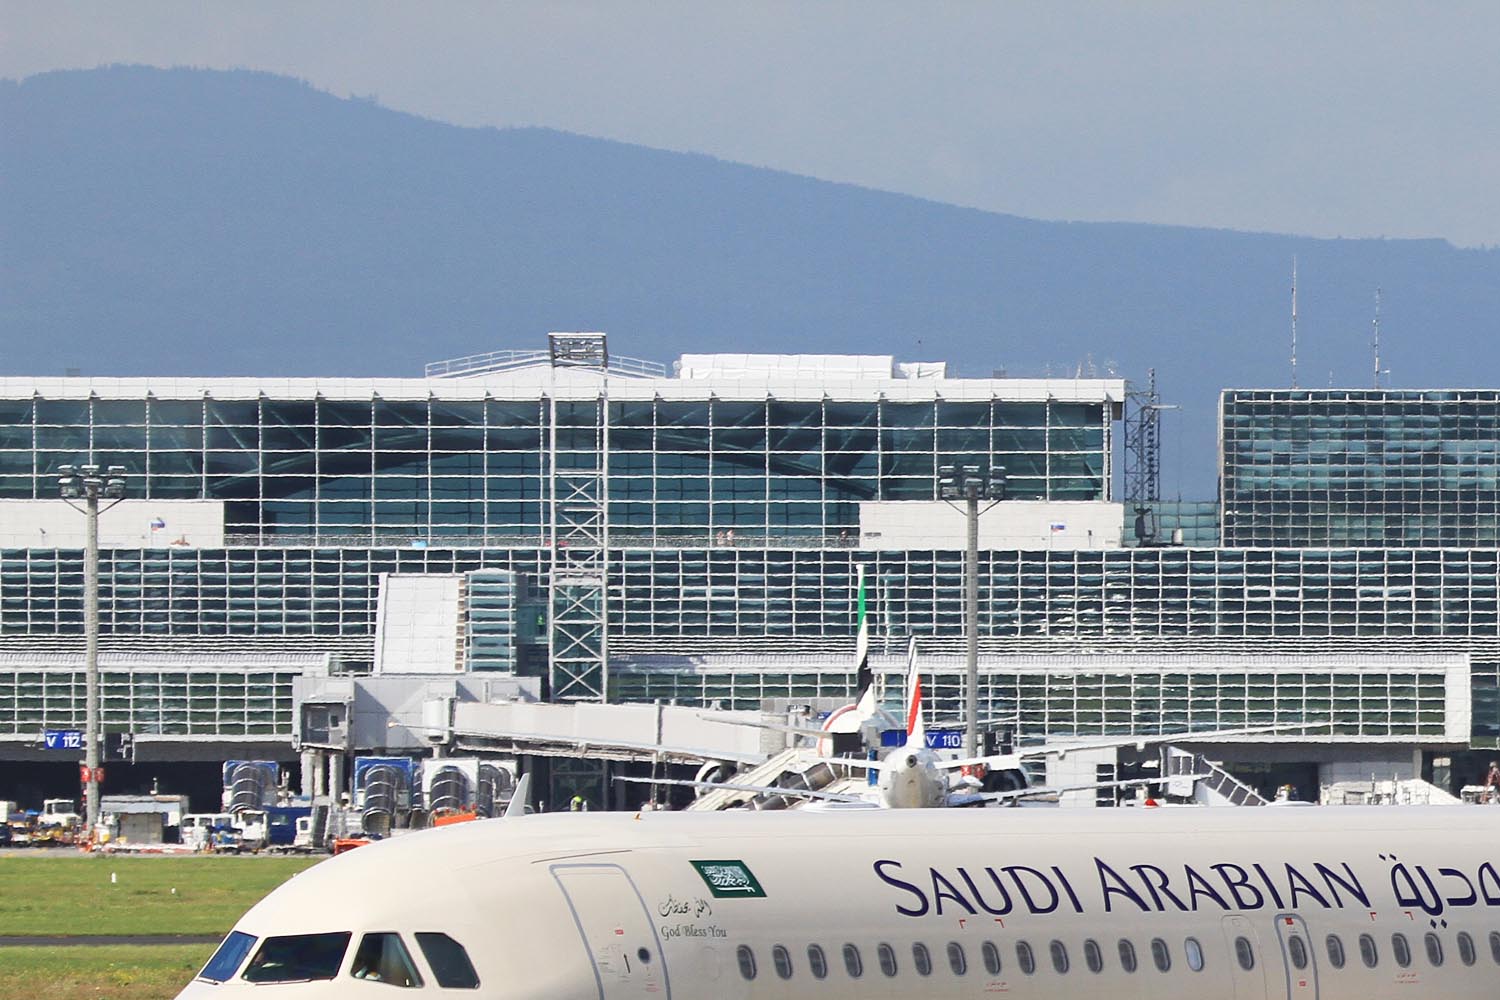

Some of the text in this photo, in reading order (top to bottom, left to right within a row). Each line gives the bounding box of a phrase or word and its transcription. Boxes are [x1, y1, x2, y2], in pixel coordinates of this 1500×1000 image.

[46, 735, 80, 748] V 112
[926, 735, 960, 747] V 110
[874, 857, 1371, 917] SAUDI ARABIAN
[661, 924, 728, 941] God Bless You
